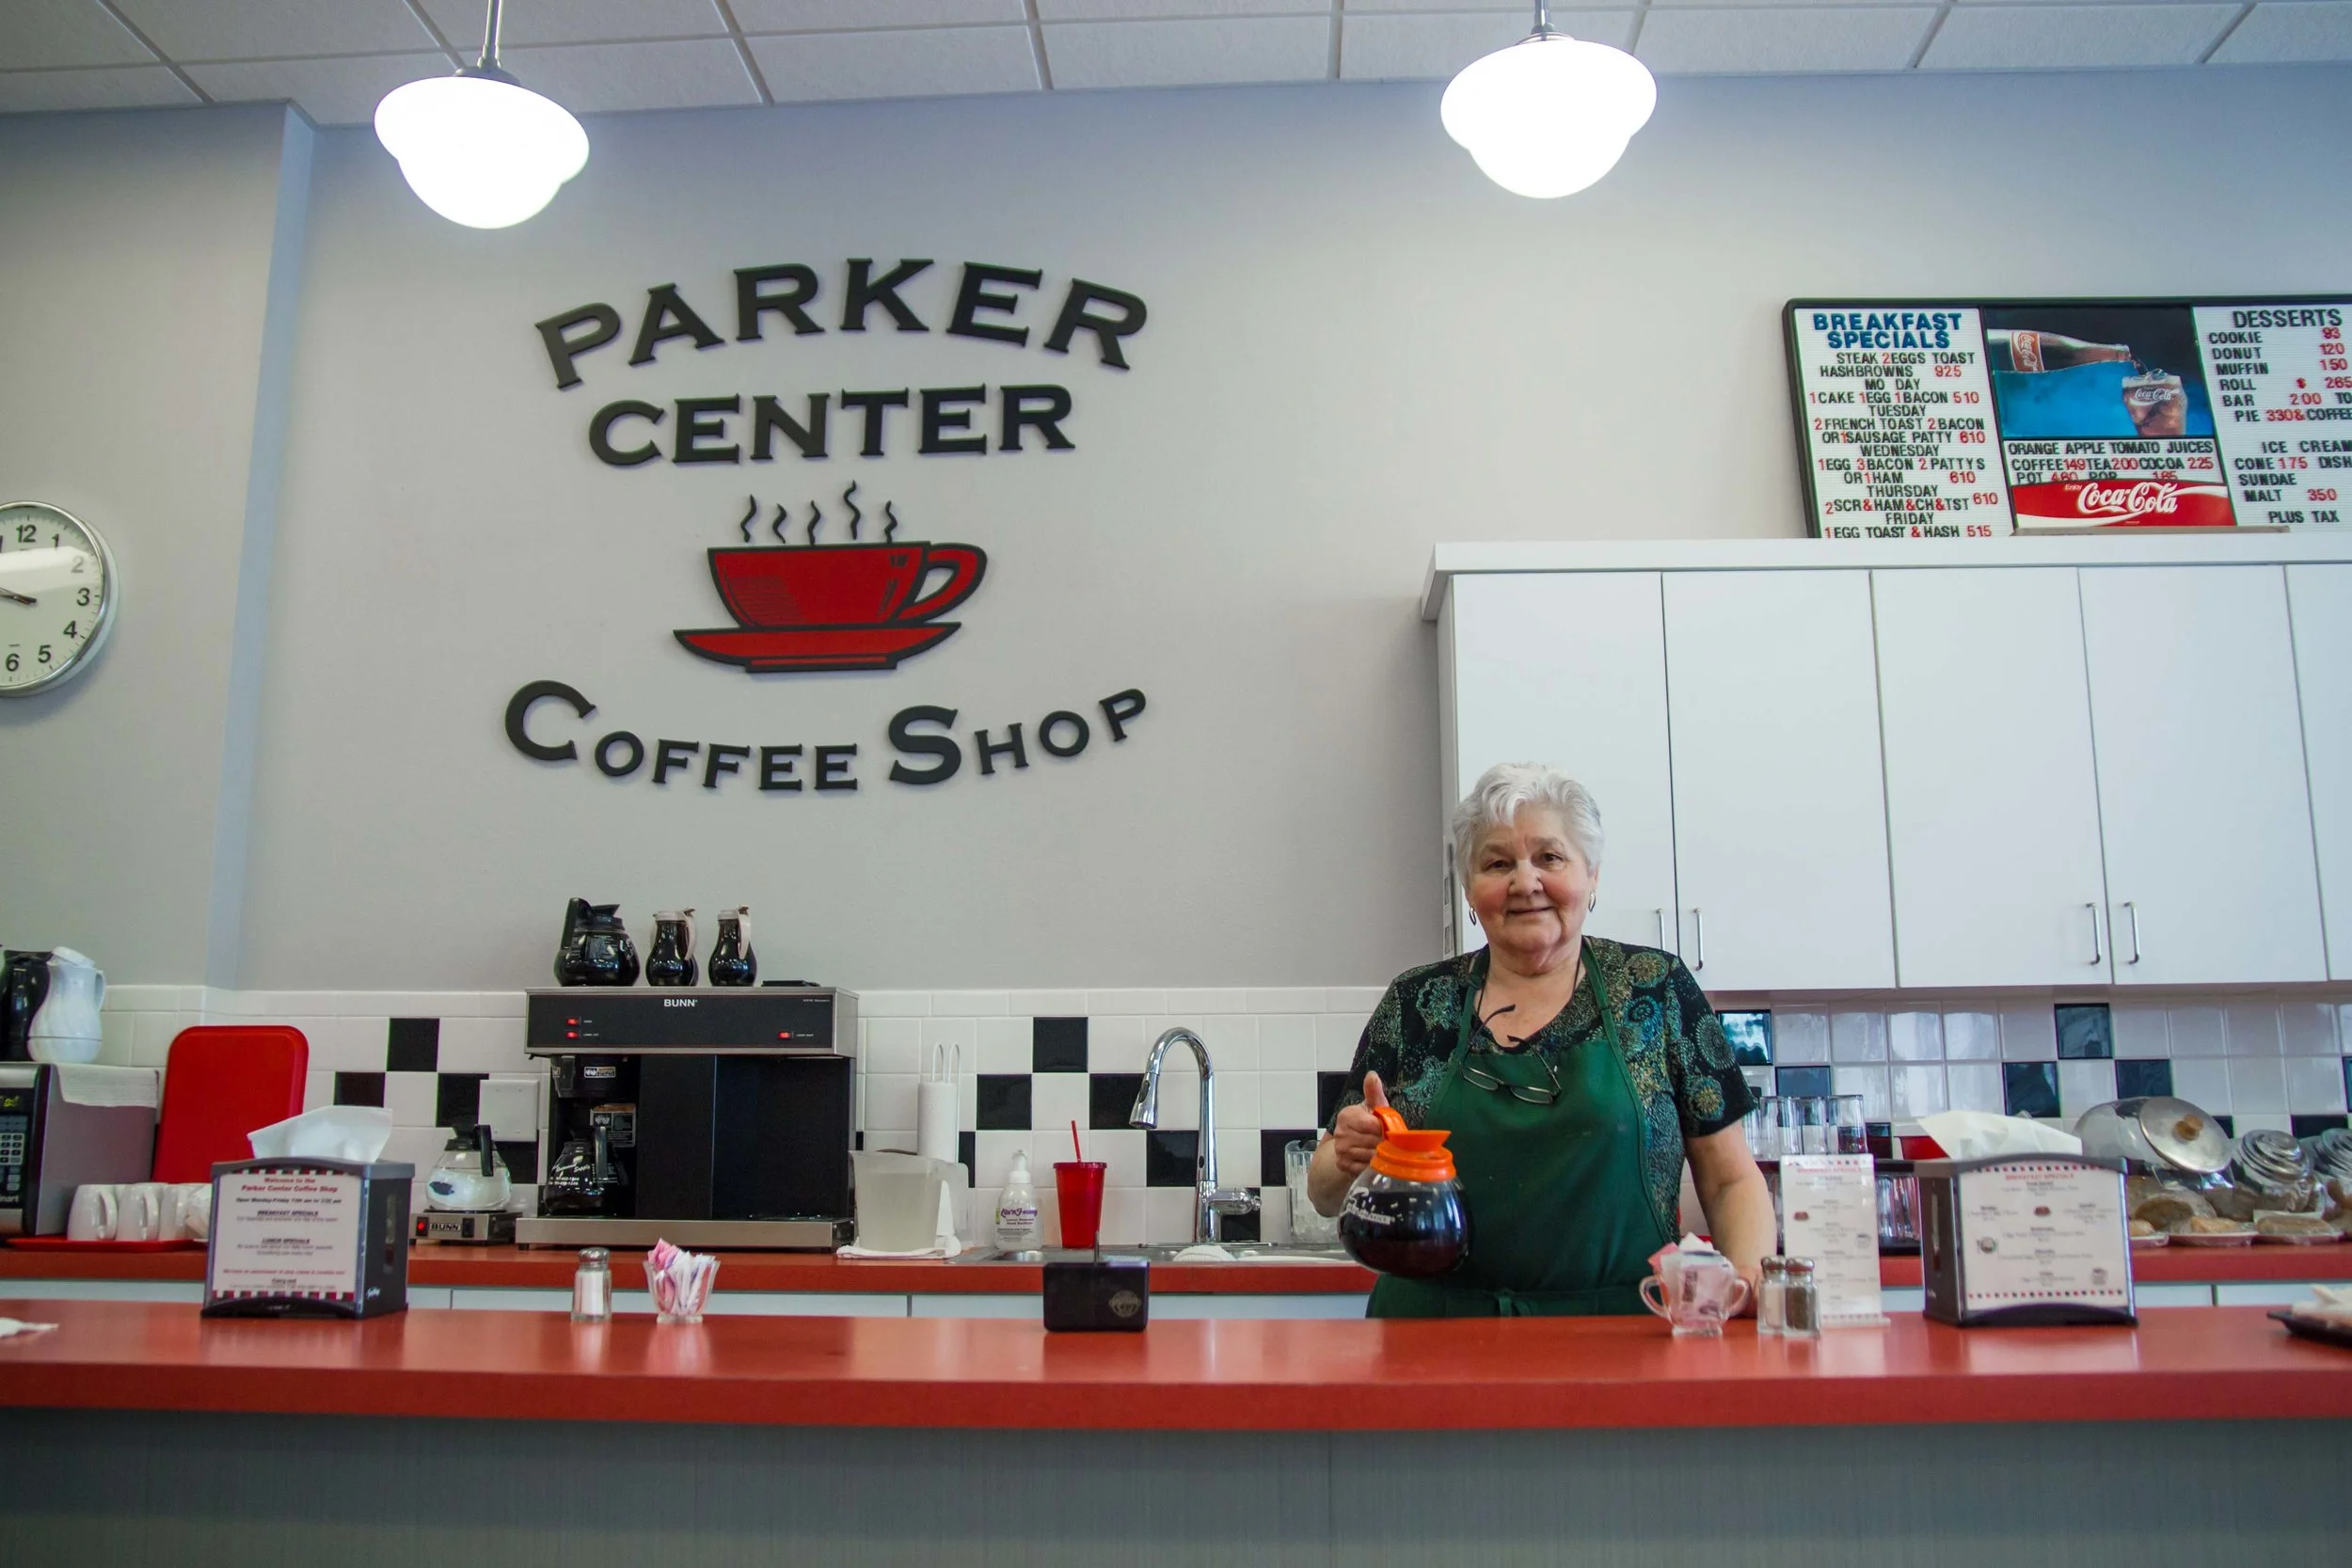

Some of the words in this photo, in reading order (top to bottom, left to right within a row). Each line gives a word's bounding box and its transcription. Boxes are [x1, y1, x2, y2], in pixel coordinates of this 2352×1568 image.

[534, 258, 1149, 390] PARKER
[1813, 313, 1963, 330] BREAKFAST
[2233, 309, 2343, 328] DESSERTS
[1827, 331, 1949, 348] SPECIALS
[2209, 331, 2263, 344] COOKIE
[2213, 347, 2262, 359] DONUT
[2320, 343, 2344, 355] 120
[1836, 353, 1878, 364] STEAK
[1932, 353, 1975, 363] TOAST
[1934, 366, 1962, 377] 925
[2216, 362, 2269, 375] MUFFIN
[2320, 358, 2348, 371] 150
[2220, 379, 2256, 390] ROLL
[2325, 377, 2352, 388] 265
[1953, 392, 1979, 403] 510
[2135, 388, 2171, 400] Coca-Cola
[2222, 394, 2254, 406] BAR
[1868, 405, 1926, 417] TUESDAY
[2235, 411, 2260, 421] PIE
[588, 383, 1076, 466] CENTER
[1880, 419, 1923, 430] TOAST
[1913, 433, 1951, 443] PATTY
[1960, 433, 1985, 443] 610
[1860, 445, 1939, 456] WEDNESDAY
[2009, 443, 2059, 454] ORANGE
[2065, 442, 2106, 454] APPLE
[2109, 442, 2160, 453] TOMATO
[2167, 441, 2213, 453] JUICES
[2262, 441, 2288, 453] ICE
[2299, 440, 2352, 452] CREAM
[2187, 457, 2214, 469] 225
[2235, 458, 2275, 469] CONE
[2279, 457, 2308, 469] 175
[2318, 456, 2352, 468] DISH
[1949, 472, 1976, 483] 610
[2017, 472, 2042, 483] POT
[2238, 473, 2297, 485] SUNDAE
[1867, 485, 1938, 497] THURSDAY
[2076, 482, 2178, 513] Coca-Cola
[2244, 489, 2281, 501] MALT
[2307, 489, 2337, 500] 350
[1973, 493, 1998, 504] 610
[1885, 513, 1934, 524] FRIDAY
[2268, 511, 2304, 523] PLUS
[2311, 511, 2340, 522] TAX
[16, 525, 37, 543] 12
[1866, 527, 1905, 538] TOAST
[1967, 527, 1991, 537] 515
[53, 534, 59, 548] 1
[71, 556, 84, 573] 2
[77, 588, 90, 607] 3
[64, 621, 77, 639] 4
[38, 645, 51, 663] 5
[6, 654, 19, 672] 6
[504, 679, 858, 792] COFFEE
[887, 688, 1147, 785] SHOP
